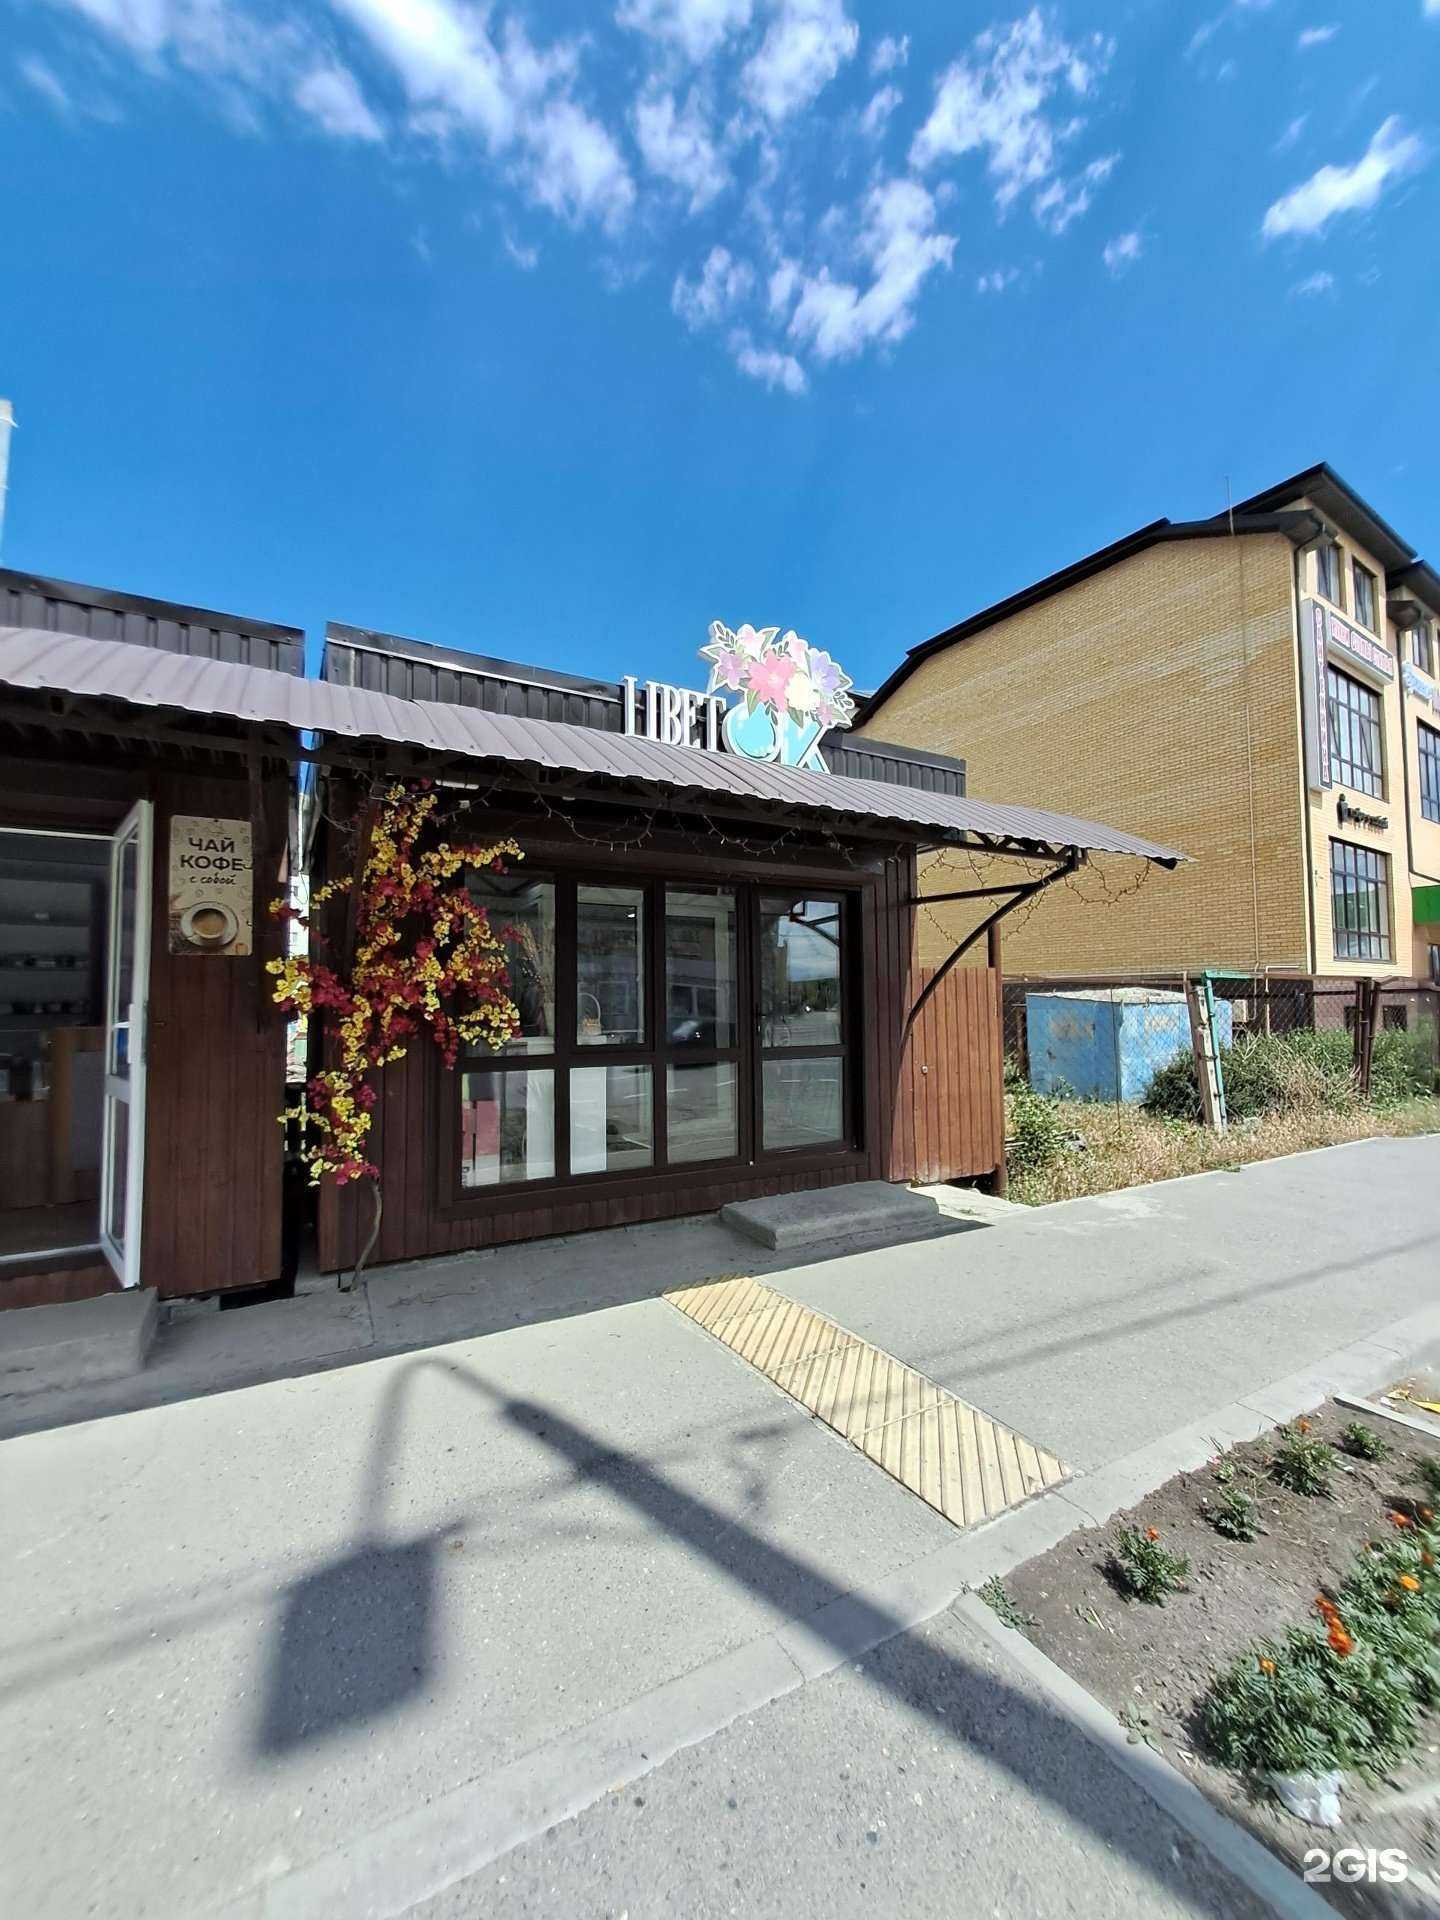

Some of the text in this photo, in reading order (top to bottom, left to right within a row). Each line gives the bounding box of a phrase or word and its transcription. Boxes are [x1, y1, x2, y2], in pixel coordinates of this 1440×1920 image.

[188, 837, 235, 854] ЧАЙ
[180, 854, 244, 871] КОФЕ
[200, 872, 237, 885] собой
